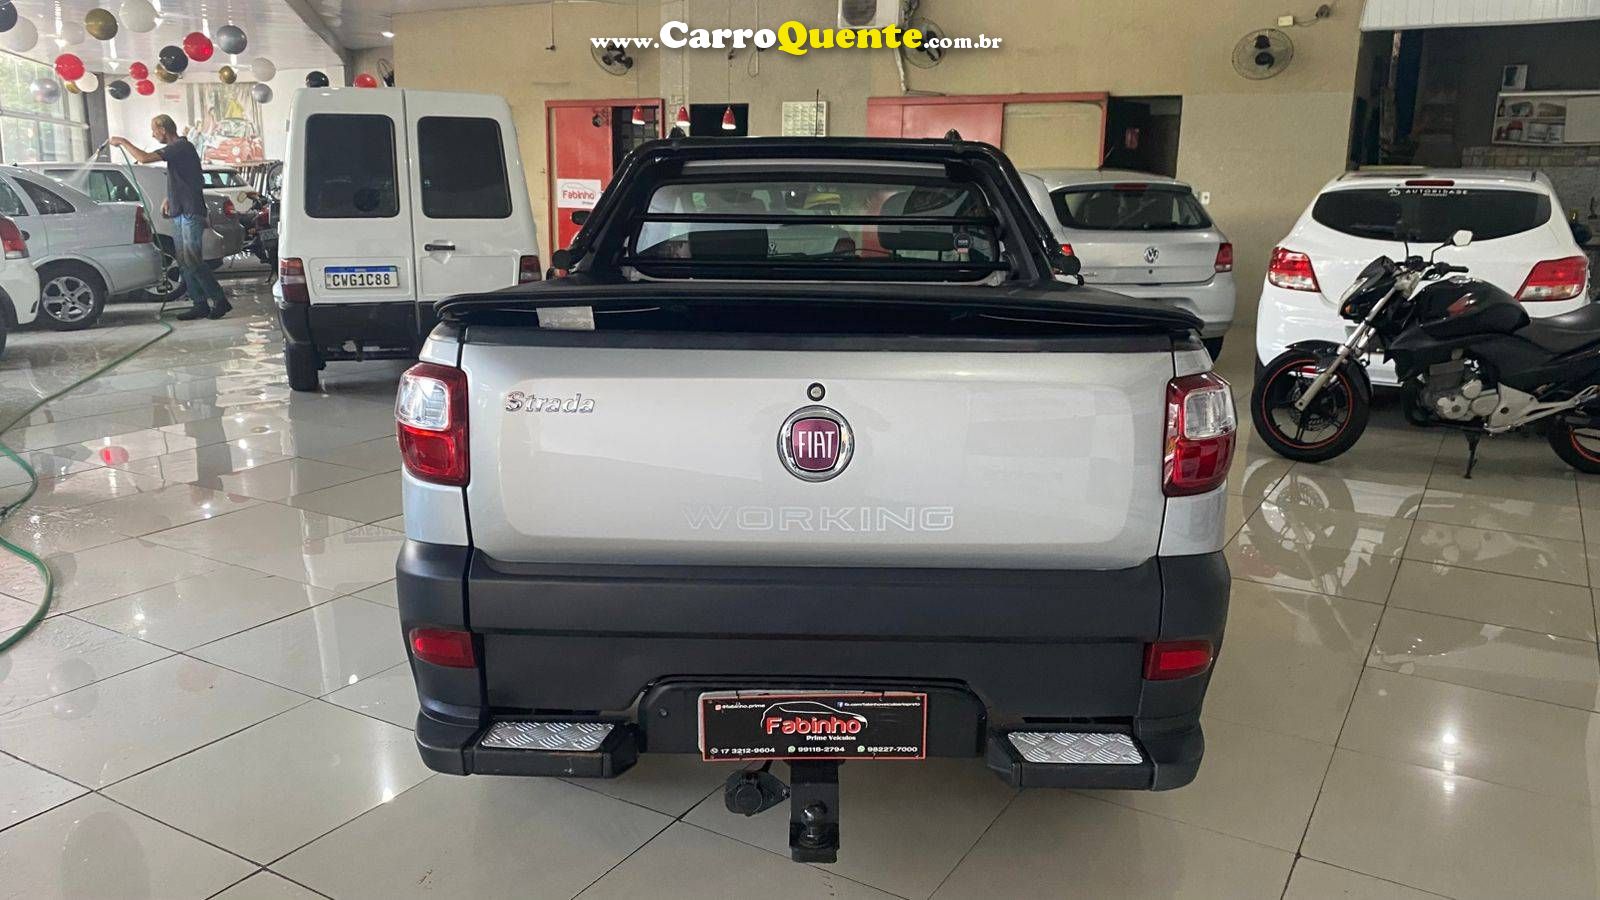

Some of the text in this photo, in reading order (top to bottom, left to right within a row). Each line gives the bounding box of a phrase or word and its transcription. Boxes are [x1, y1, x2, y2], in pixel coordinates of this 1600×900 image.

[562, 191, 596, 200] Fabinho
[332, 273, 391, 287] CWG1C88
[505, 391, 595, 413] Strada
[798, 431, 836, 459] FIAT
[681, 505, 955, 532] WORKING
[766, 716, 862, 735] Fabinho
